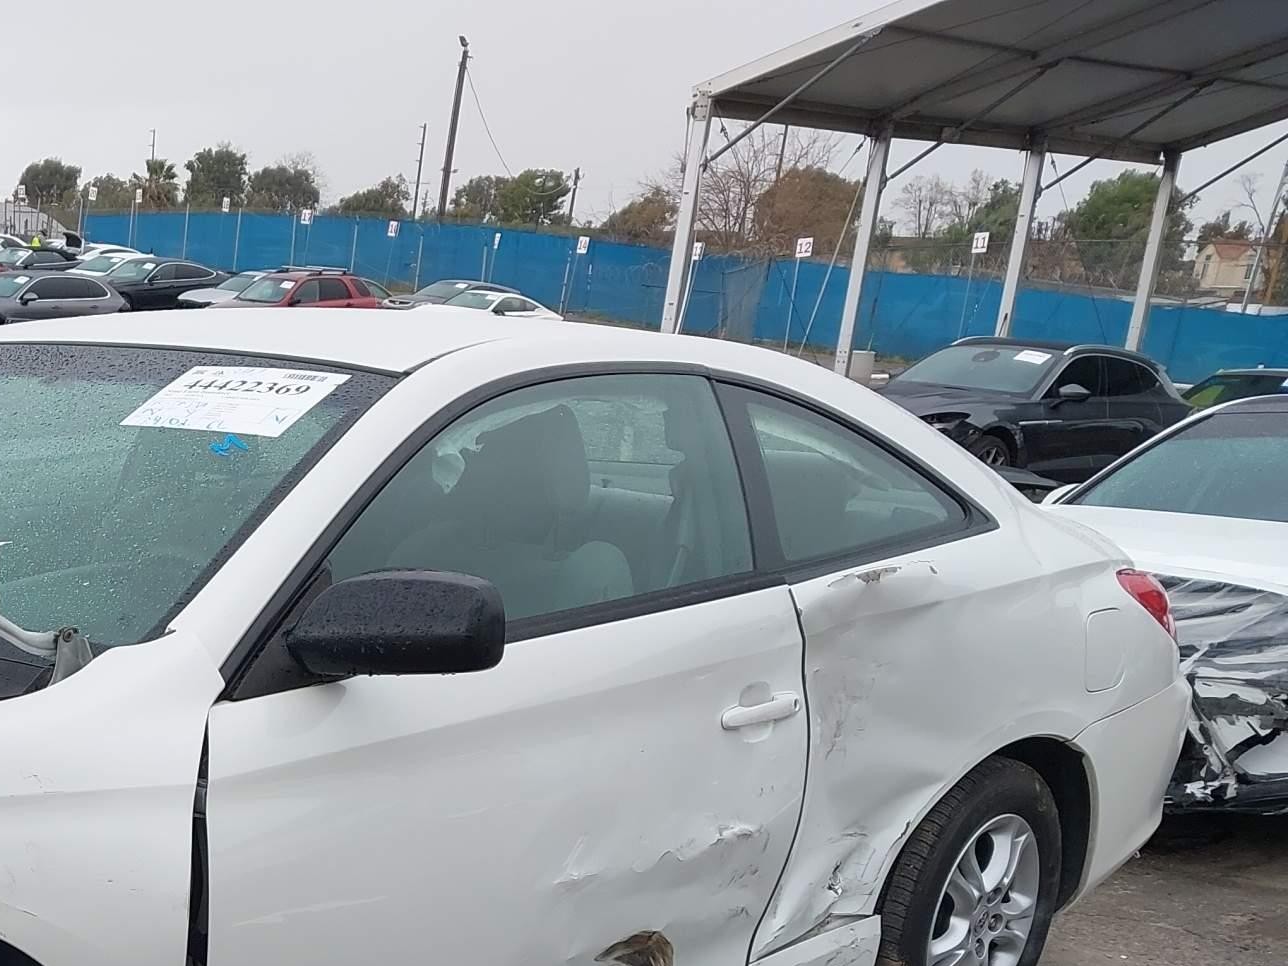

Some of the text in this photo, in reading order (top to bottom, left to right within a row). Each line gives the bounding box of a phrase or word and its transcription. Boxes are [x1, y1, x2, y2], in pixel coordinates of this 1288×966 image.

[797, 242, 811, 255] 12
[974, 236, 987, 250] 11
[184, 378, 312, 397] 44422369
